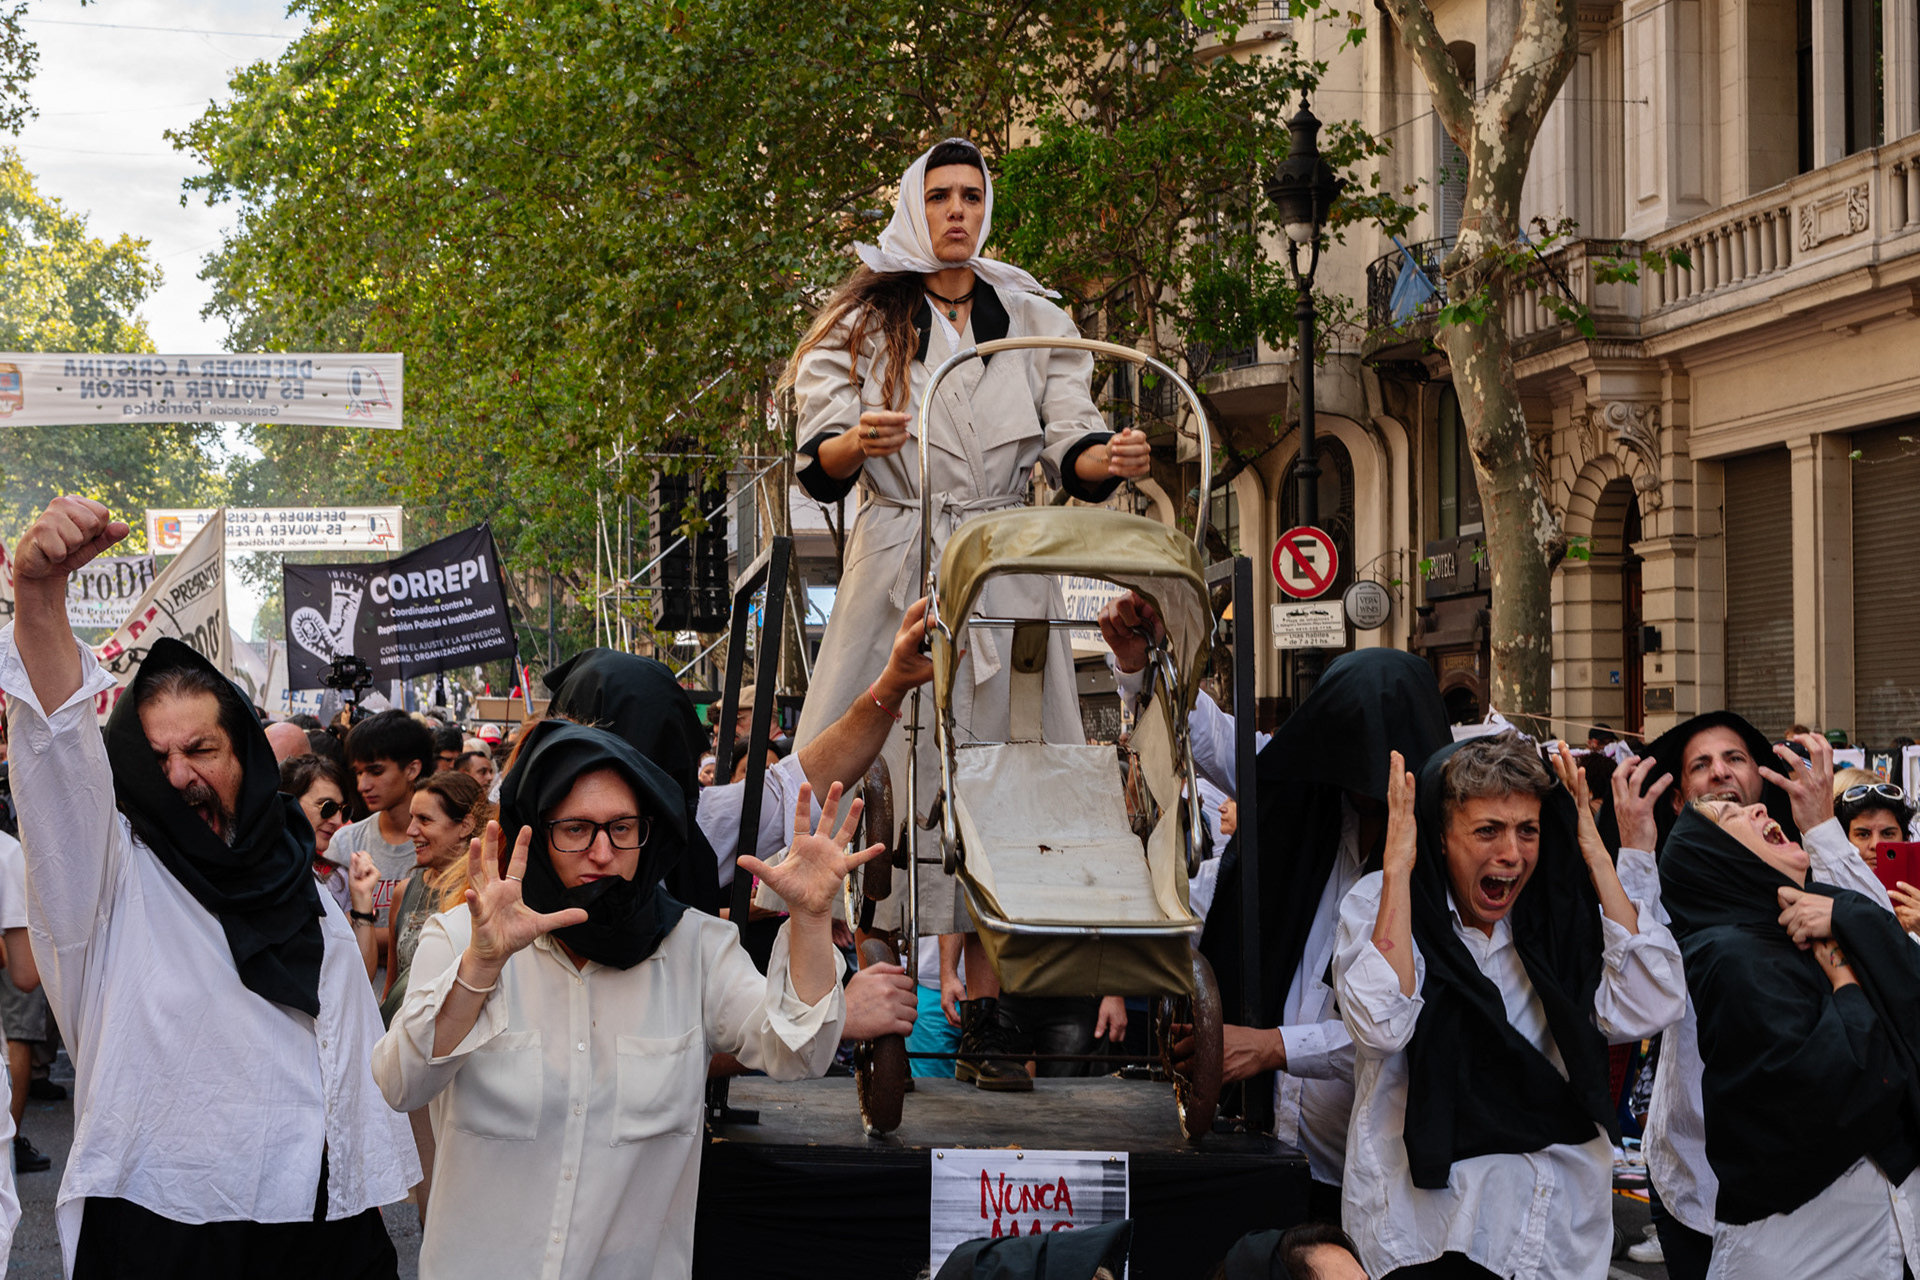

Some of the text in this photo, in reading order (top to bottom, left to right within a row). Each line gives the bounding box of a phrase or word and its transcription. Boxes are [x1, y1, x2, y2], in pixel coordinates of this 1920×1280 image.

[369, 554, 489, 605] CORREPI
[87, 606, 135, 616] Profesio
[377, 621, 414, 636] Represión
[413, 617, 442, 633] Policial
[447, 604, 496, 625] Institucional
[390, 597, 473, 617] Coordinadora contra la
[380, 626, 502, 656] CONTRA EL AJUSTE Y LA REPRESIÓN
[414, 643, 471, 662] ORGANIZACIÓN
[471, 642, 478, 651] Y
[479, 636, 507, 650] LUCHA!
[980, 1168, 1074, 1220] NUNCA
